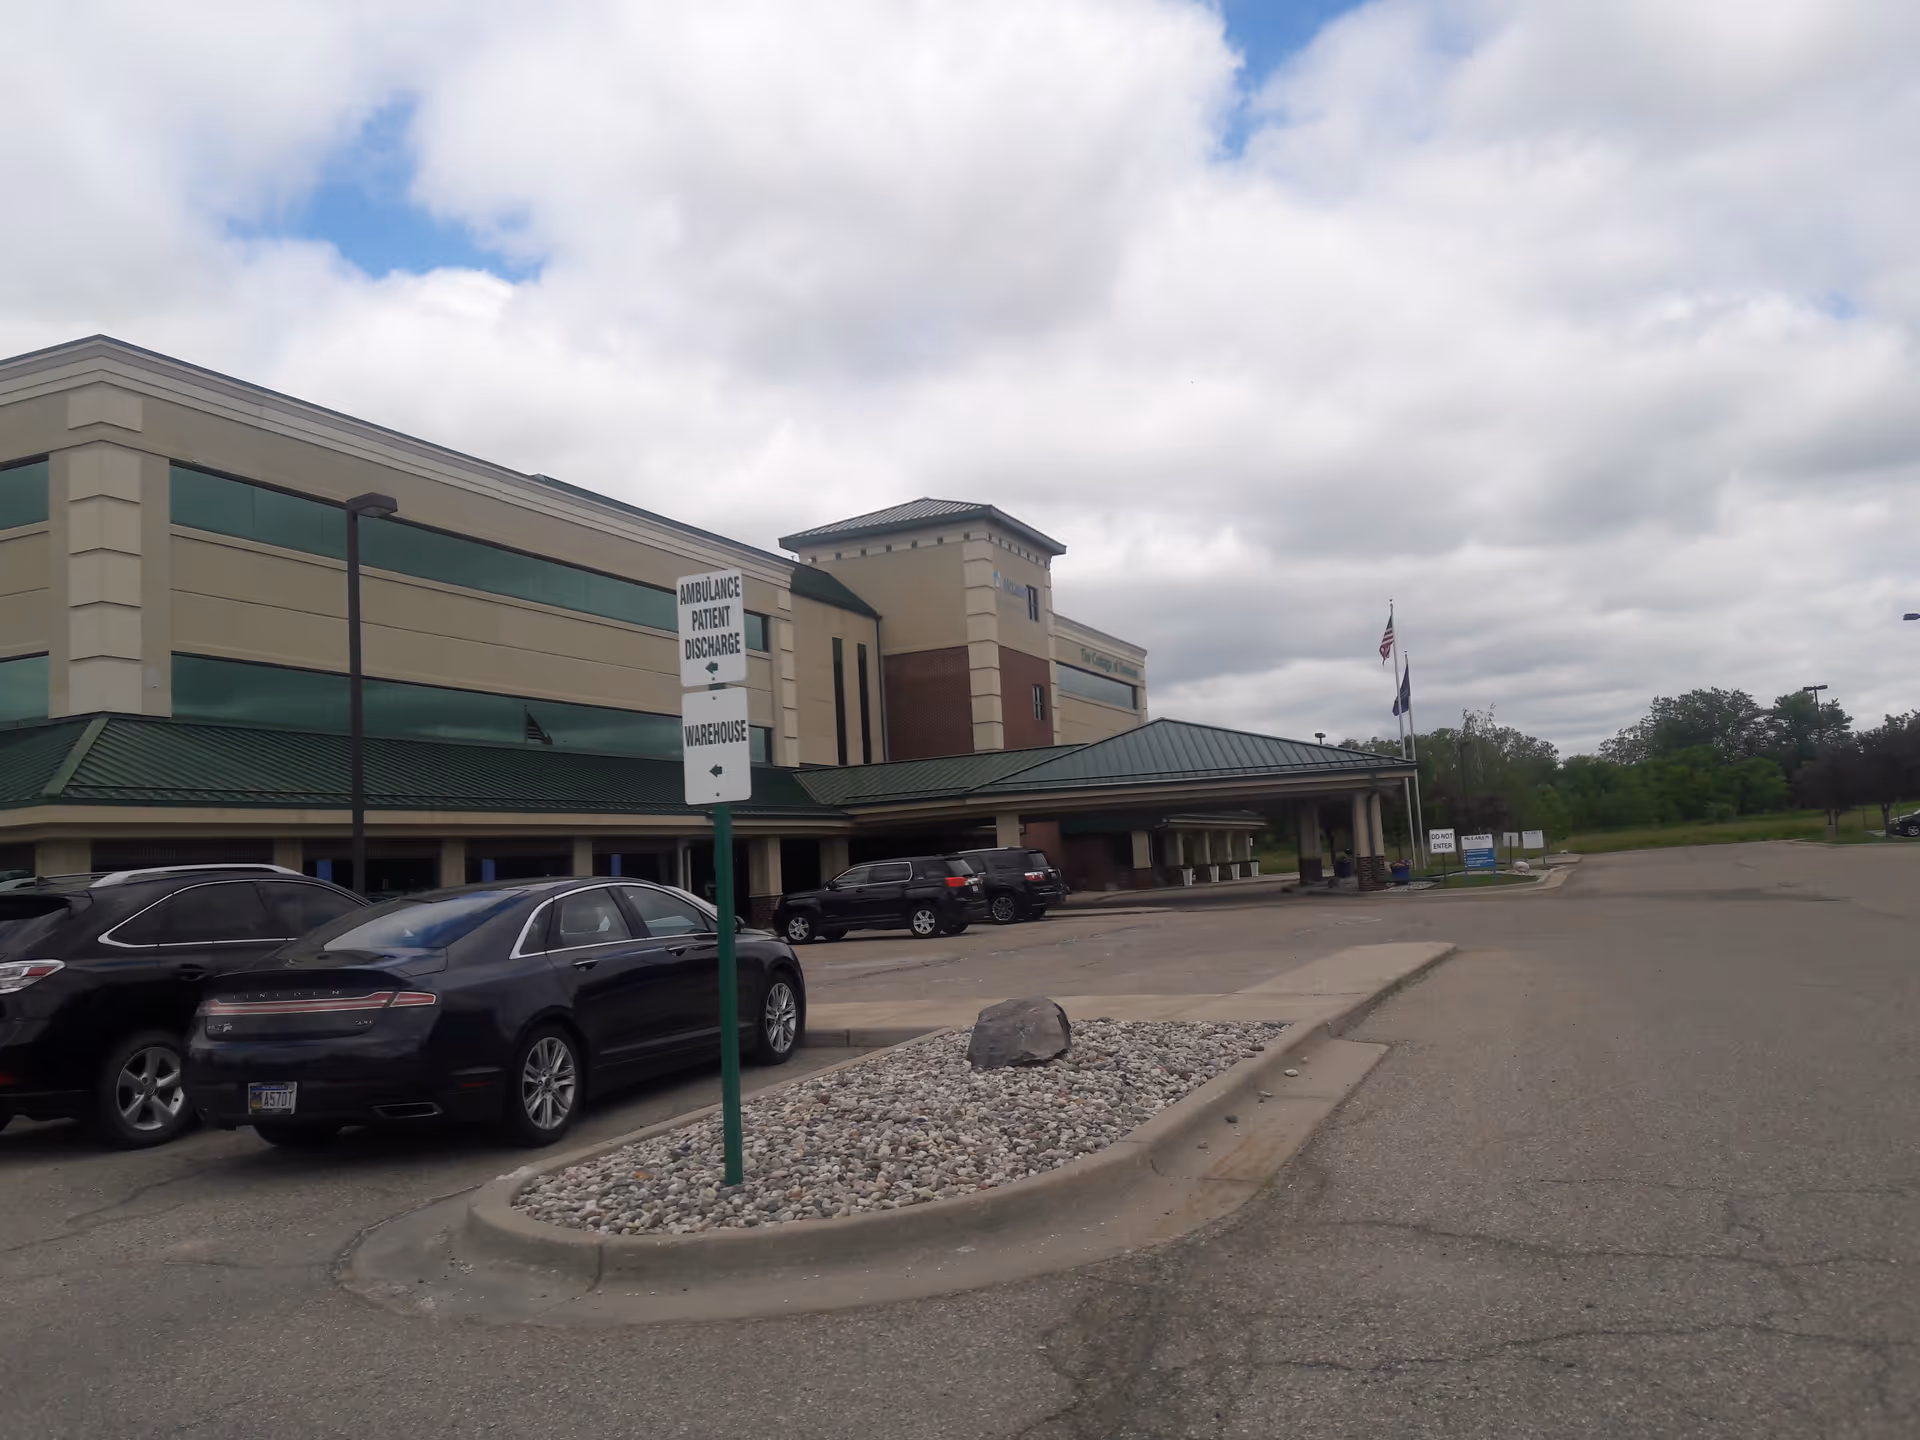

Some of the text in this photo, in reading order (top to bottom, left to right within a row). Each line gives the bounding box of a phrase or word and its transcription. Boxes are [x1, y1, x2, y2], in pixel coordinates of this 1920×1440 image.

[680, 576, 740, 605] AMBULANCE
[692, 606, 731, 631] PATIENT
[685, 632, 740, 660] DISCHARGE
[684, 720, 747, 747] WAREHOUSE
